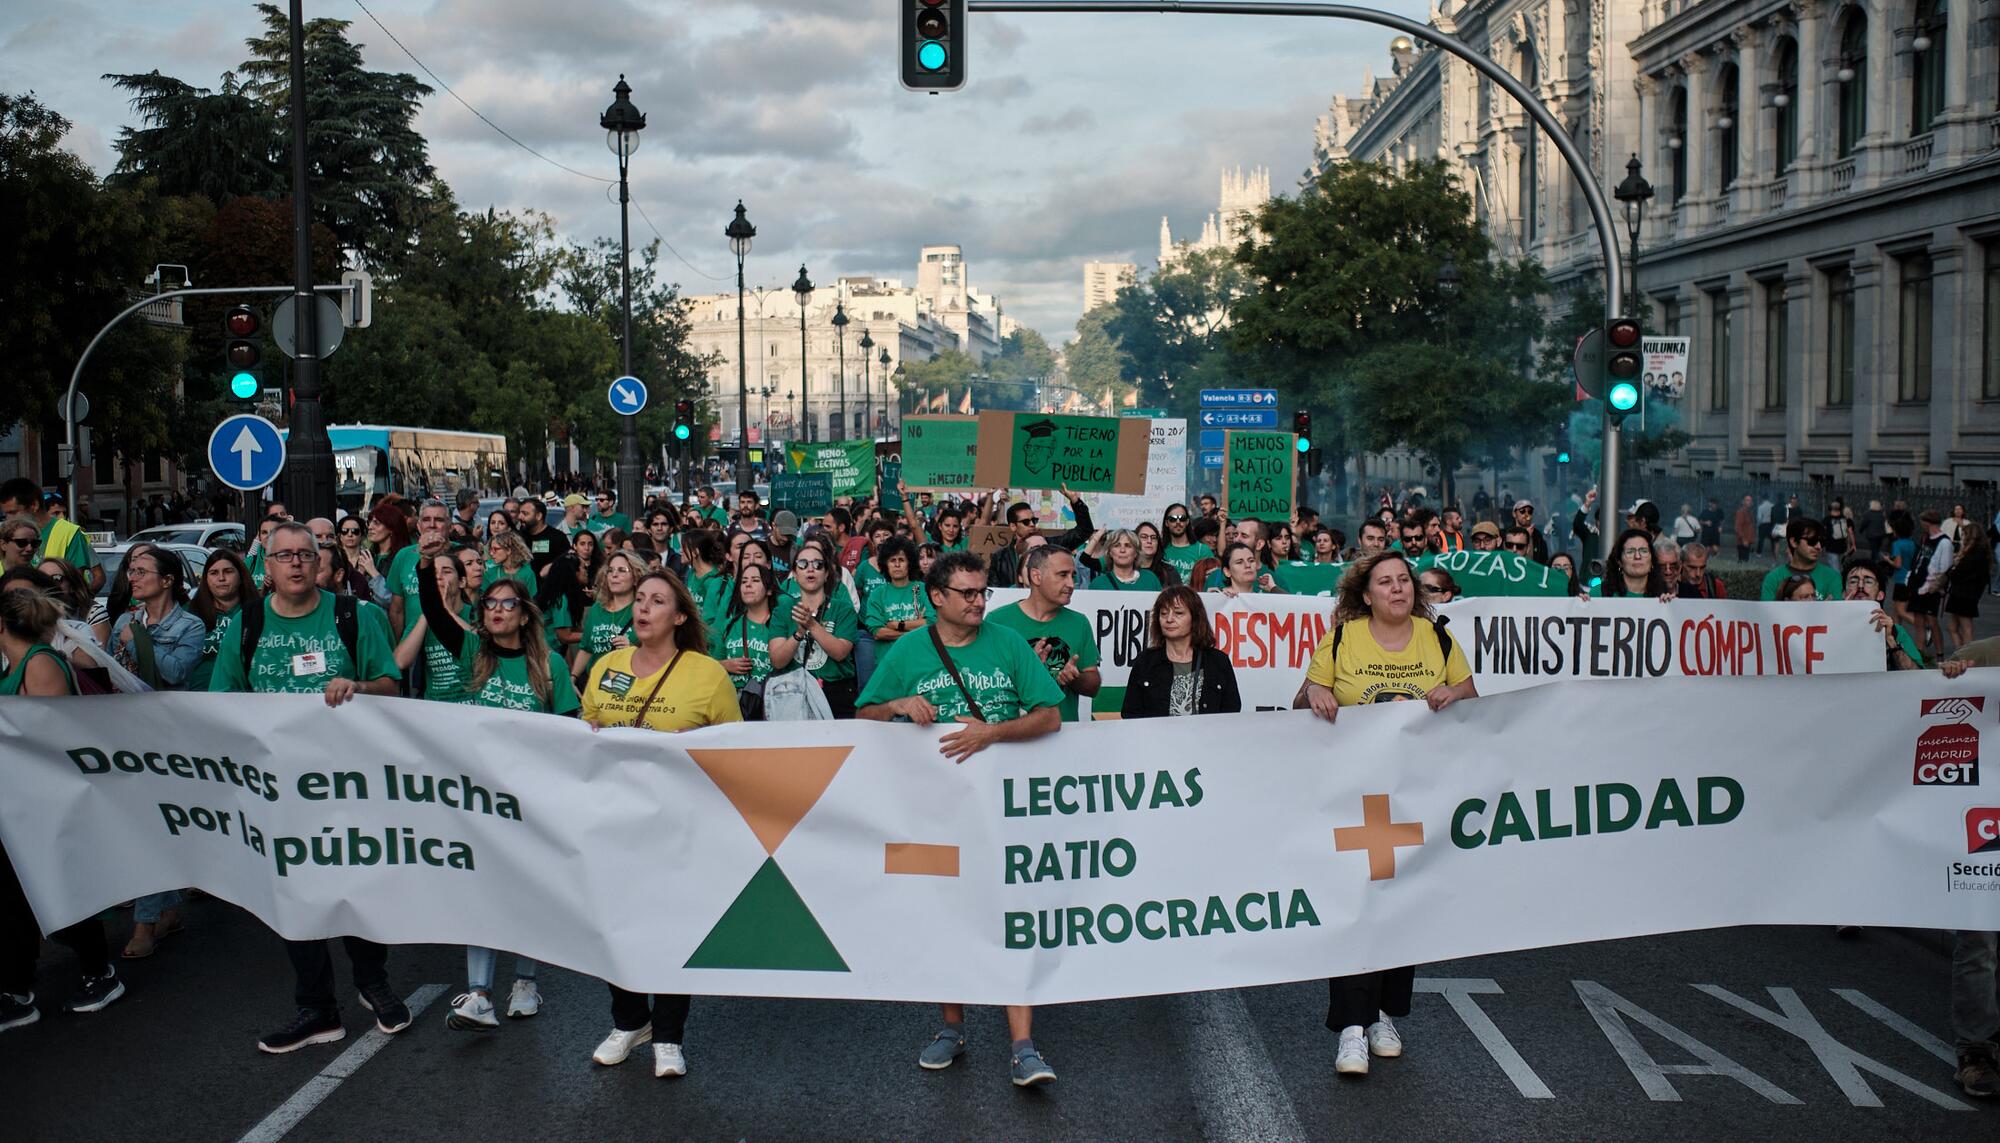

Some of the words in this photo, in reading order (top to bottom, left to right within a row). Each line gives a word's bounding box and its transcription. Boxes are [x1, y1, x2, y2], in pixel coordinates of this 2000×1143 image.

[1643, 342, 1686, 354] KULUNKA
[1203, 394, 1236, 402] Valencia
[908, 425, 922, 438] NO
[818, 449, 847, 459] MENOS
[1063, 446, 1083, 457] POR
[1090, 448, 1103, 459] LA
[815, 458, 850, 468] LECTIVAS
[1052, 460, 1112, 483] PÚBLICA
[1234, 456, 1284, 475] RATIO
[832, 478, 856, 488] ATIVA
[1229, 496, 1290, 514] CALIDAD
[1434, 550, 1527, 583] ROZAS
[1473, 616, 1672, 678] MINISTERIO
[1386, 670, 1426, 679] EDUCATIVA
[626, 705, 662, 714] EDUTIVA
[1918, 735, 1978, 747] enseñanza
[1920, 749, 1972, 761] MADRID
[1918, 763, 1974, 784] CGT
[66, 747, 279, 802] Docentes
[299, 764, 369, 800] en
[384, 764, 523, 822] lucha
[1004, 767, 1204, 818] LECTIVAS
[1450, 776, 1745, 850] CALIDAD
[1977, 818, 2000, 841] C
[158, 802, 231, 836] por
[239, 810, 267, 857] la
[273, 826, 476, 877] pública
[1005, 838, 1137, 885] RATIO
[1953, 862, 2000, 877] Secció
[1005, 889, 1321, 950] BUROCRACIA
[1412, 978, 1980, 1112] TAXI
